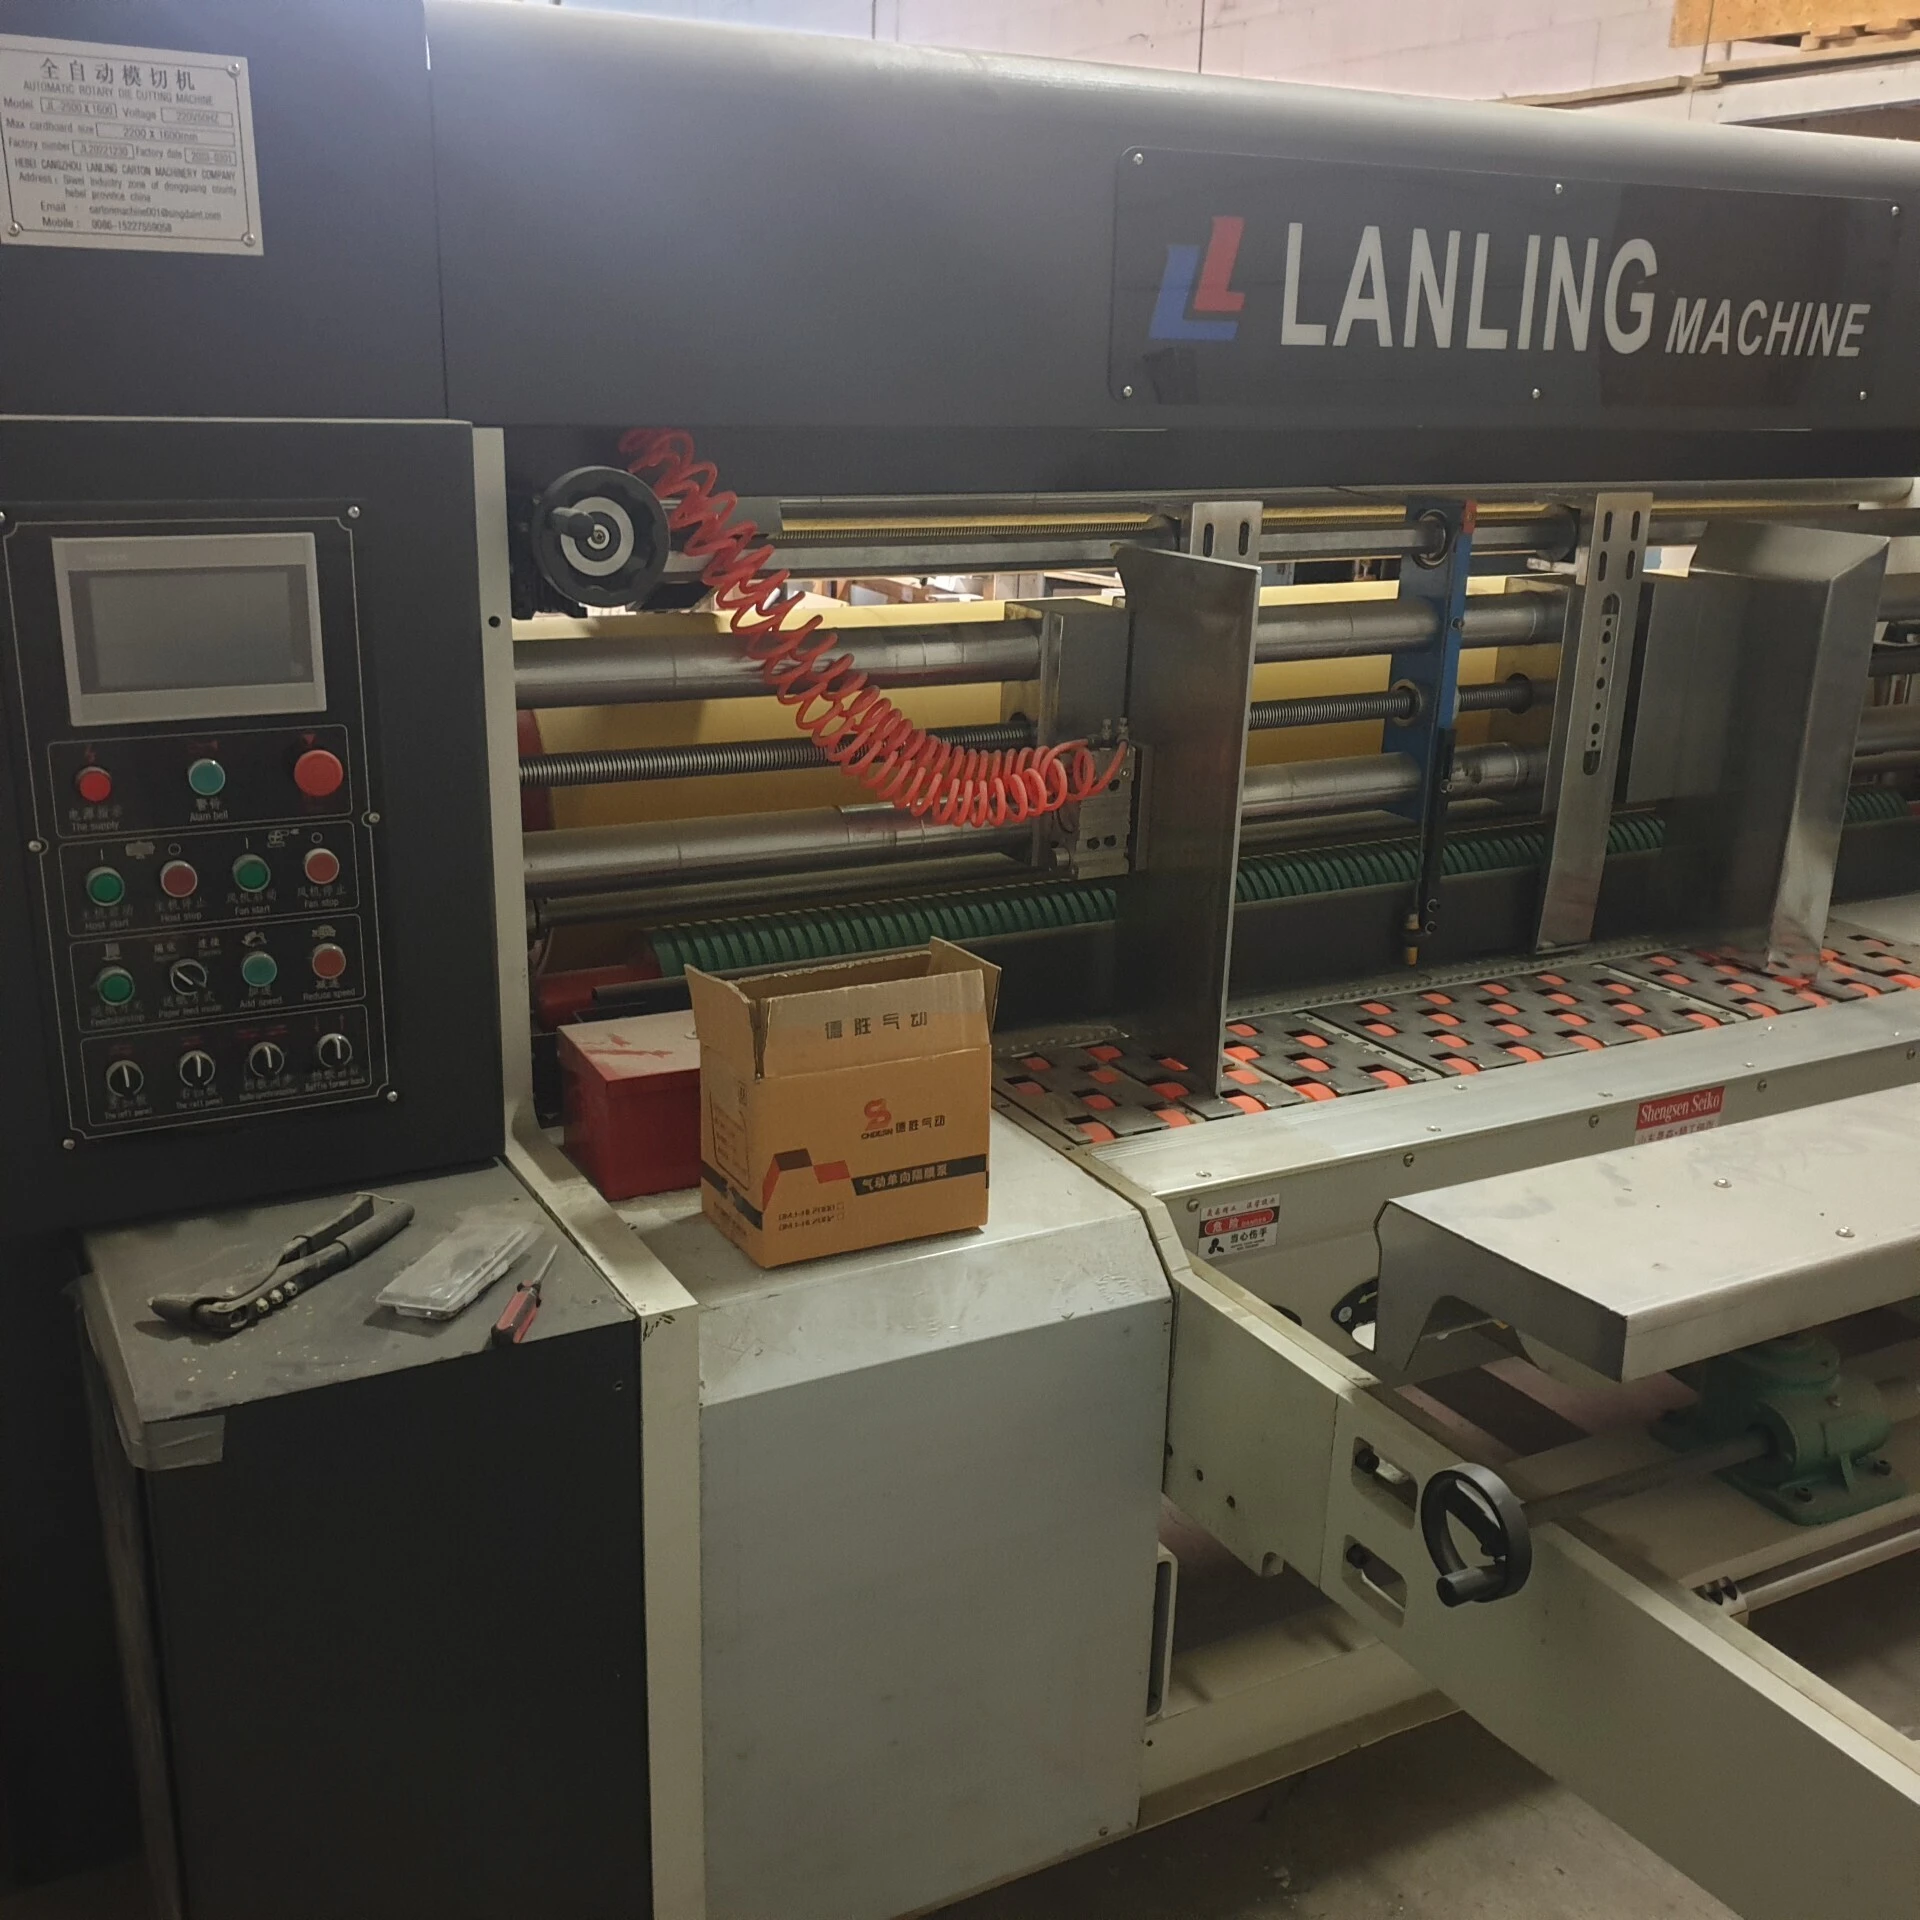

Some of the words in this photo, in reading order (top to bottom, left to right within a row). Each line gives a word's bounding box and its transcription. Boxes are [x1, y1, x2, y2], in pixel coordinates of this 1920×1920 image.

[40, 56, 195, 91] 全自动模切机
[23, 80, 75, 94] AUTOMATIC
[78, 84, 114, 97] ROTARY
[136, 90, 172, 103] CUTTING
[176, 93, 214, 106] MACHINE
[3, 96, 34, 110] Model
[122, 107, 157, 121] Voltage
[5, 116, 25, 129] Max
[29, 120, 73, 133] cardboard
[135, 146, 164, 159] Factory
[14, 157, 37, 169] HEBEI
[40, 158, 82, 172] CANGZHOU
[86, 161, 118, 174] LANLING
[121, 164, 151, 176] CARTON
[155, 166, 197, 179] MACHINERY
[201, 168, 236, 181] COMPANY
[1281, 222, 1658, 355] LANLING
[1664, 297, 1872, 358] MACHINE
[213, 809, 229, 821] bell
[1641, 1101, 1689, 1123] Shengsen
[1691, 1092, 1720, 1112] Seiko
